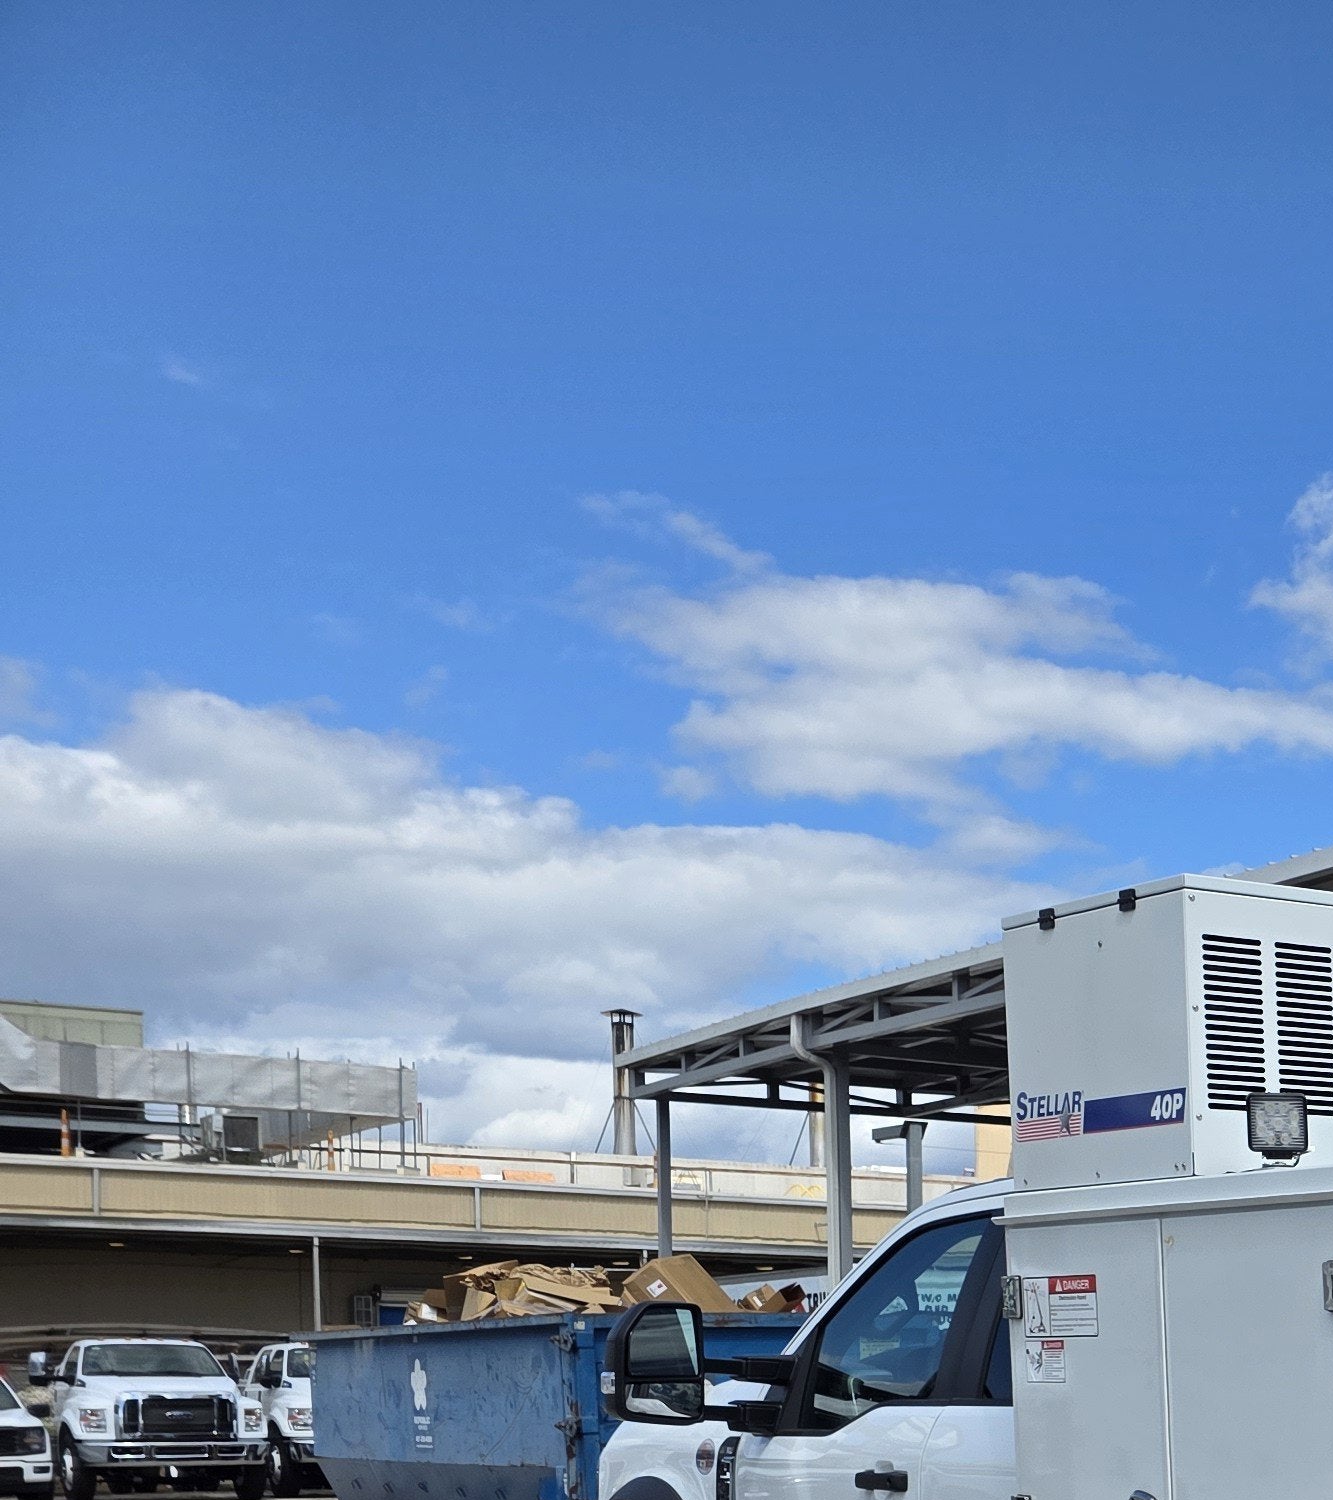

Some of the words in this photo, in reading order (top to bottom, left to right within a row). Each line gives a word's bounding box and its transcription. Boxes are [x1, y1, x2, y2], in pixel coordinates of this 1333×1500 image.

[1016, 1090, 1082, 1120] STELLAR
[1150, 1093, 1183, 1121] 40P
[1062, 1279, 1090, 1291] DANGER
